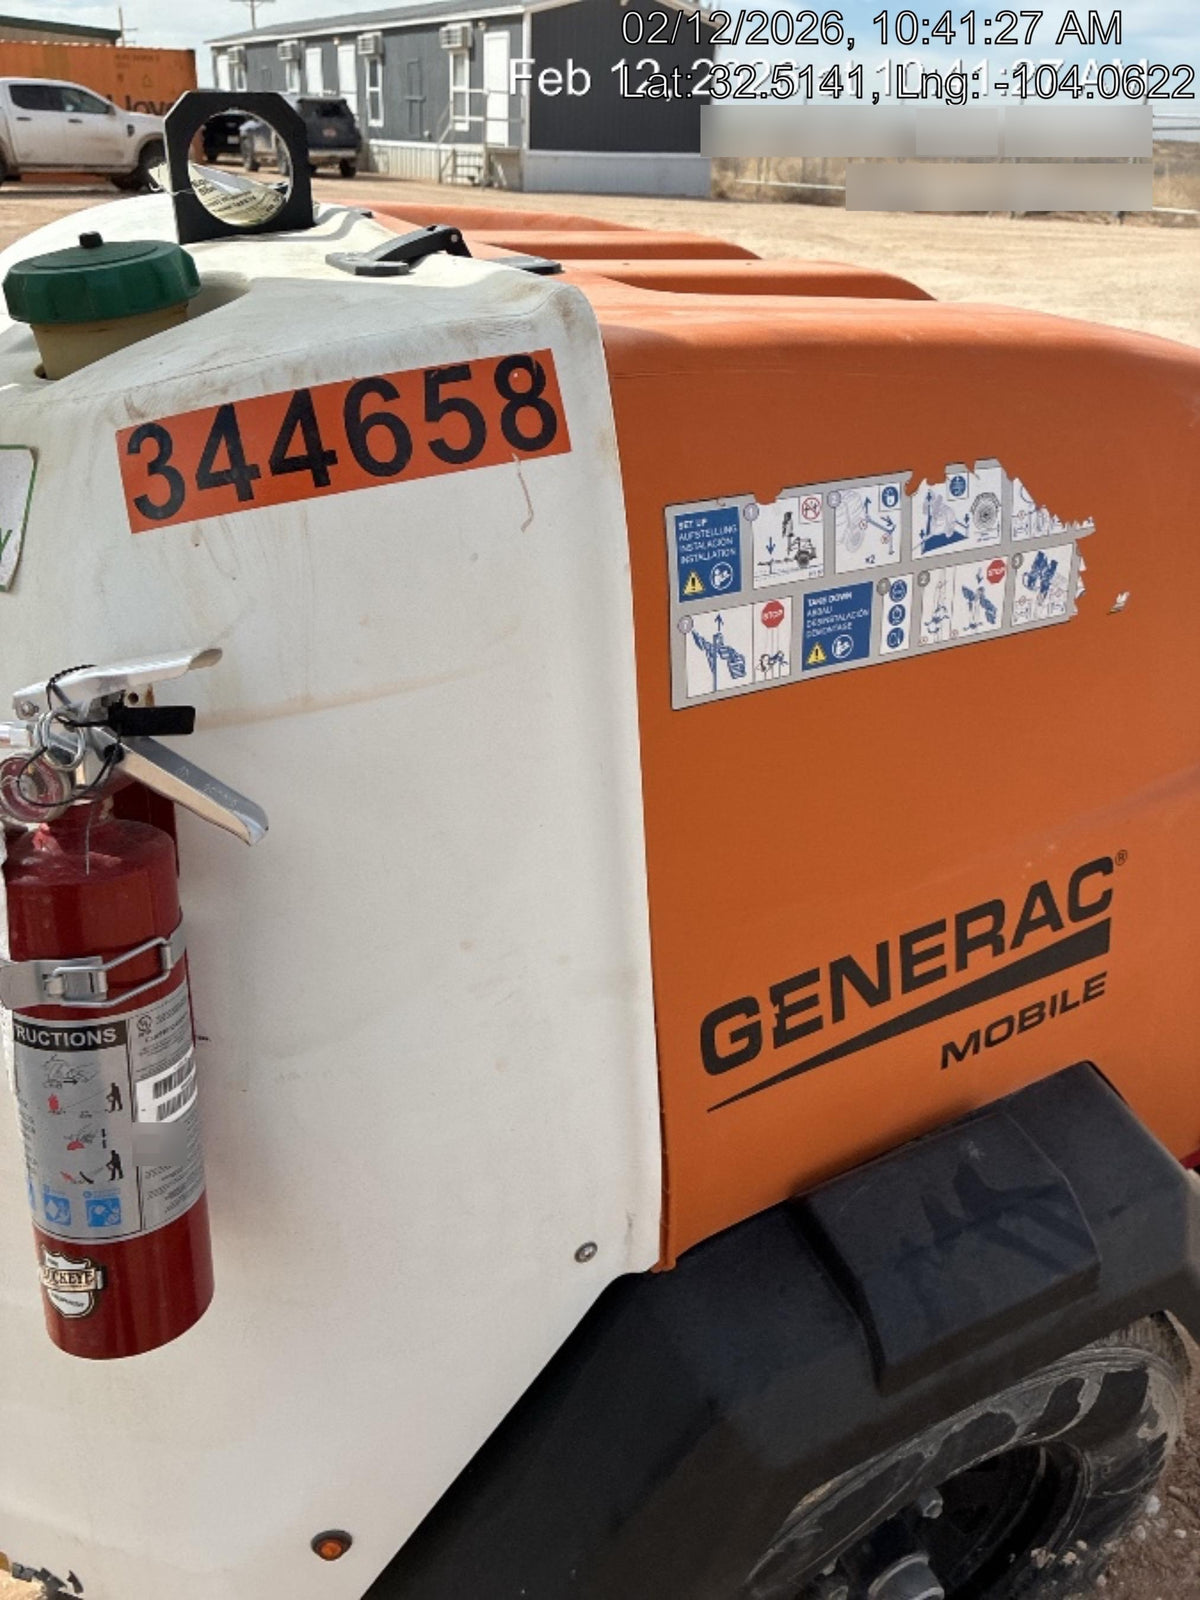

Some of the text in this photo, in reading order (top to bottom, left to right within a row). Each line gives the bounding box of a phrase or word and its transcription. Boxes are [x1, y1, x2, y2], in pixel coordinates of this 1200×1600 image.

[126, 354, 558, 520] 344658
[762, 608, 784, 621] STOP
[987, 568, 1006, 578] STOP
[699, 855, 1114, 1076] GENERAC
[941, 971, 1108, 1070] MOBILE
